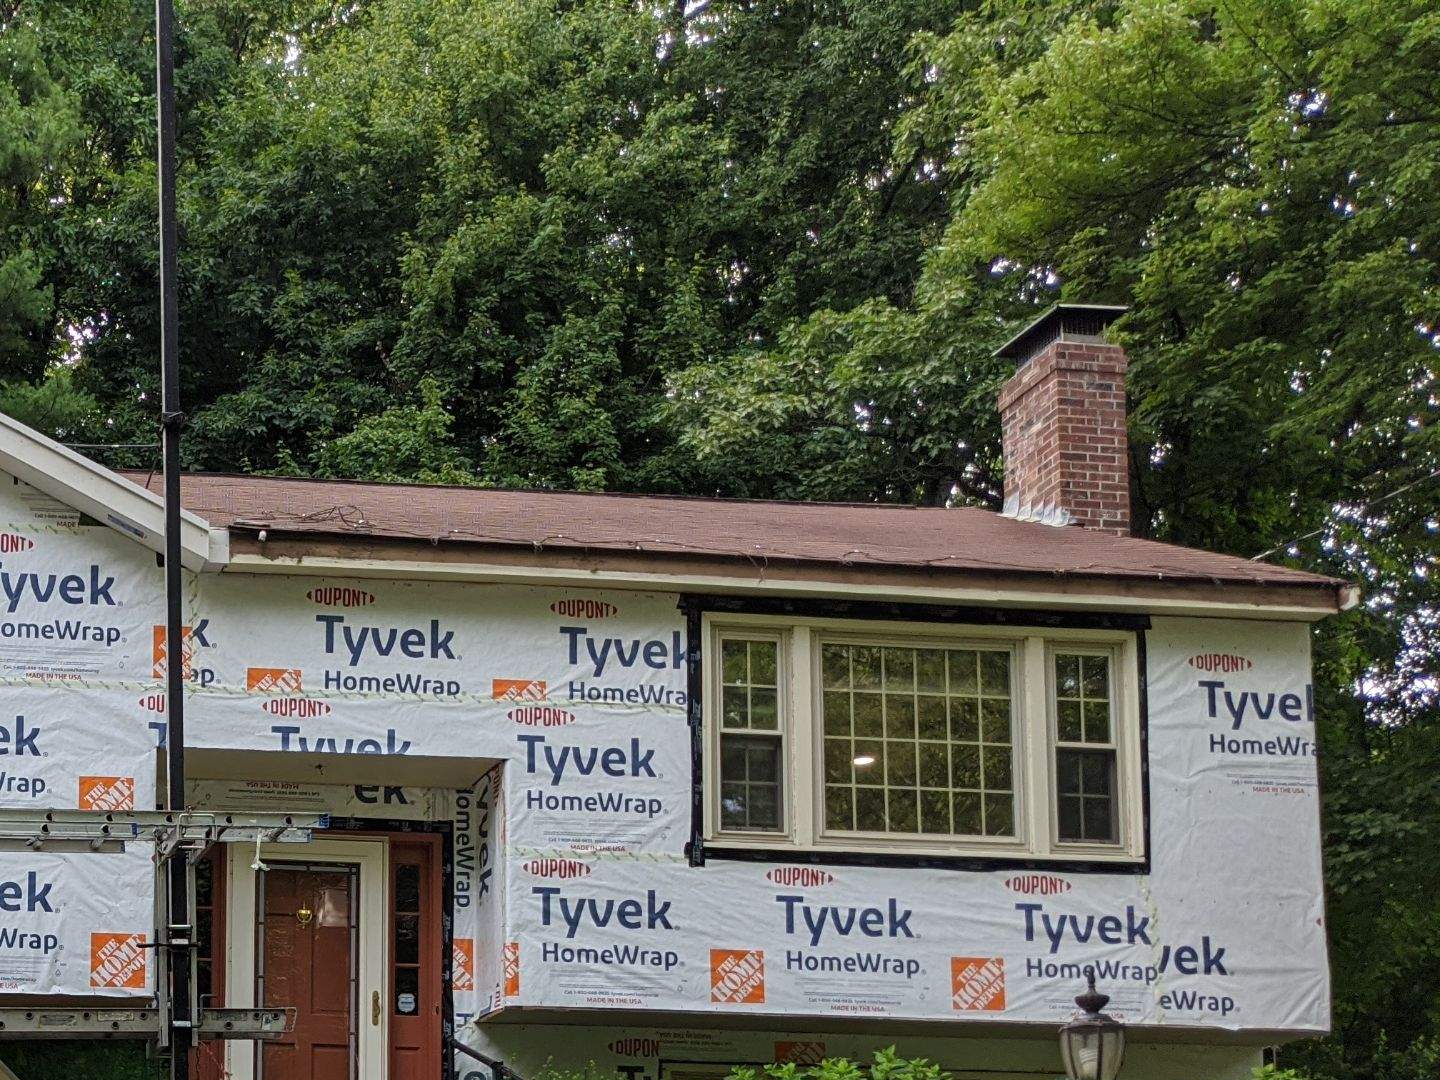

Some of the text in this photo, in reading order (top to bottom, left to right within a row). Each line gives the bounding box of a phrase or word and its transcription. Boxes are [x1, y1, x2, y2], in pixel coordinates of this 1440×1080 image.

[314, 588, 367, 608] DUPONT
[558, 599, 611, 619] DUPONT
[315, 615, 455, 666] Tyvek
[1196, 654, 1246, 672] DUPONT
[568, 681, 687, 706] HomeWra
[271, 699, 324, 717] DUPONT
[514, 708, 568, 727] DUPONT
[517, 735, 657, 785] Tyvek
[84, 782, 108, 804] THE
[527, 790, 662, 818] HomeWrap
[531, 860, 584, 878] DUPONT
[774, 868, 826, 887] DUPONT
[1013, 876, 1065, 895] DUPONT
[532, 887, 672, 938] Tyvek
[776, 896, 914, 946] Tyvek
[1015, 903, 1151, 953] Tyvek
[90, 934, 146, 986] HOME
[95, 939, 120, 960] THE
[543, 943, 678, 971] HomeWrap
[111, 955, 145, 988] DEPOT
[710, 950, 765, 1001] HOME
[715, 955, 739, 976] THE
[786, 951, 920, 979] HomeWrap
[956, 963, 980, 984] THE
[731, 971, 764, 1003] DEPOT
[951, 958, 1005, 1008] HOME
[972, 978, 1004, 1010] DEPOT
[1160, 991, 1235, 1016] eWrap
[616, 1039, 660, 1058] DUPON
